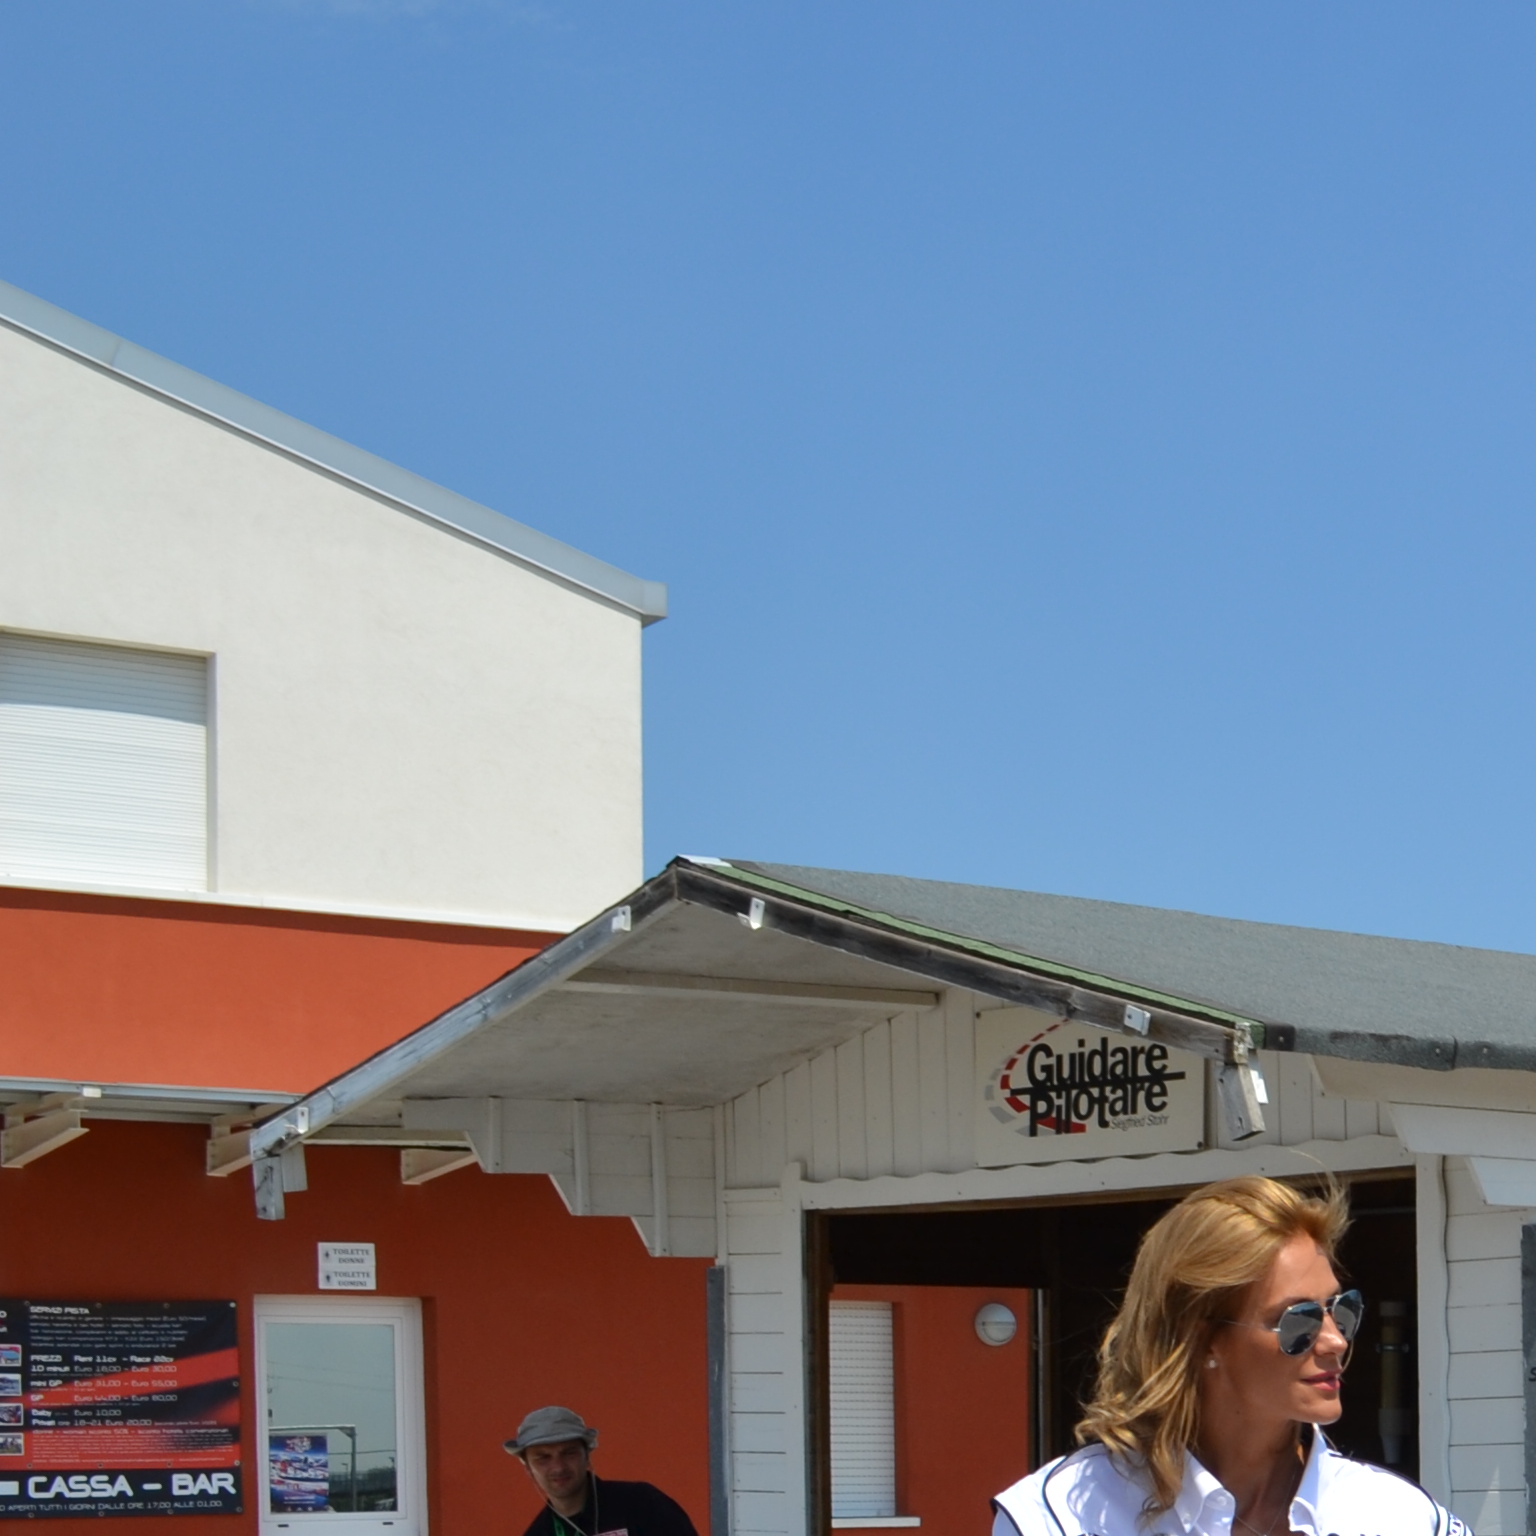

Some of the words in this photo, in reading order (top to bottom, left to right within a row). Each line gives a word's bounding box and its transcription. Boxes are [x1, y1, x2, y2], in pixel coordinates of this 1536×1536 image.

[1027, 1037, 1168, 1088] Guidare
[1029, 1082, 1169, 1137] Pilotare
[74, 1365, 93, 1373] Euro
[131, 1365, 150, 1373] Euro
[74, 1380, 93, 1388] Euro
[131, 1380, 150, 1388] Euro
[74, 1409, 93, 1417] Euro
[28, 1475, 134, 1499] CASSA
[172, 1473, 236, 1496] BAR
